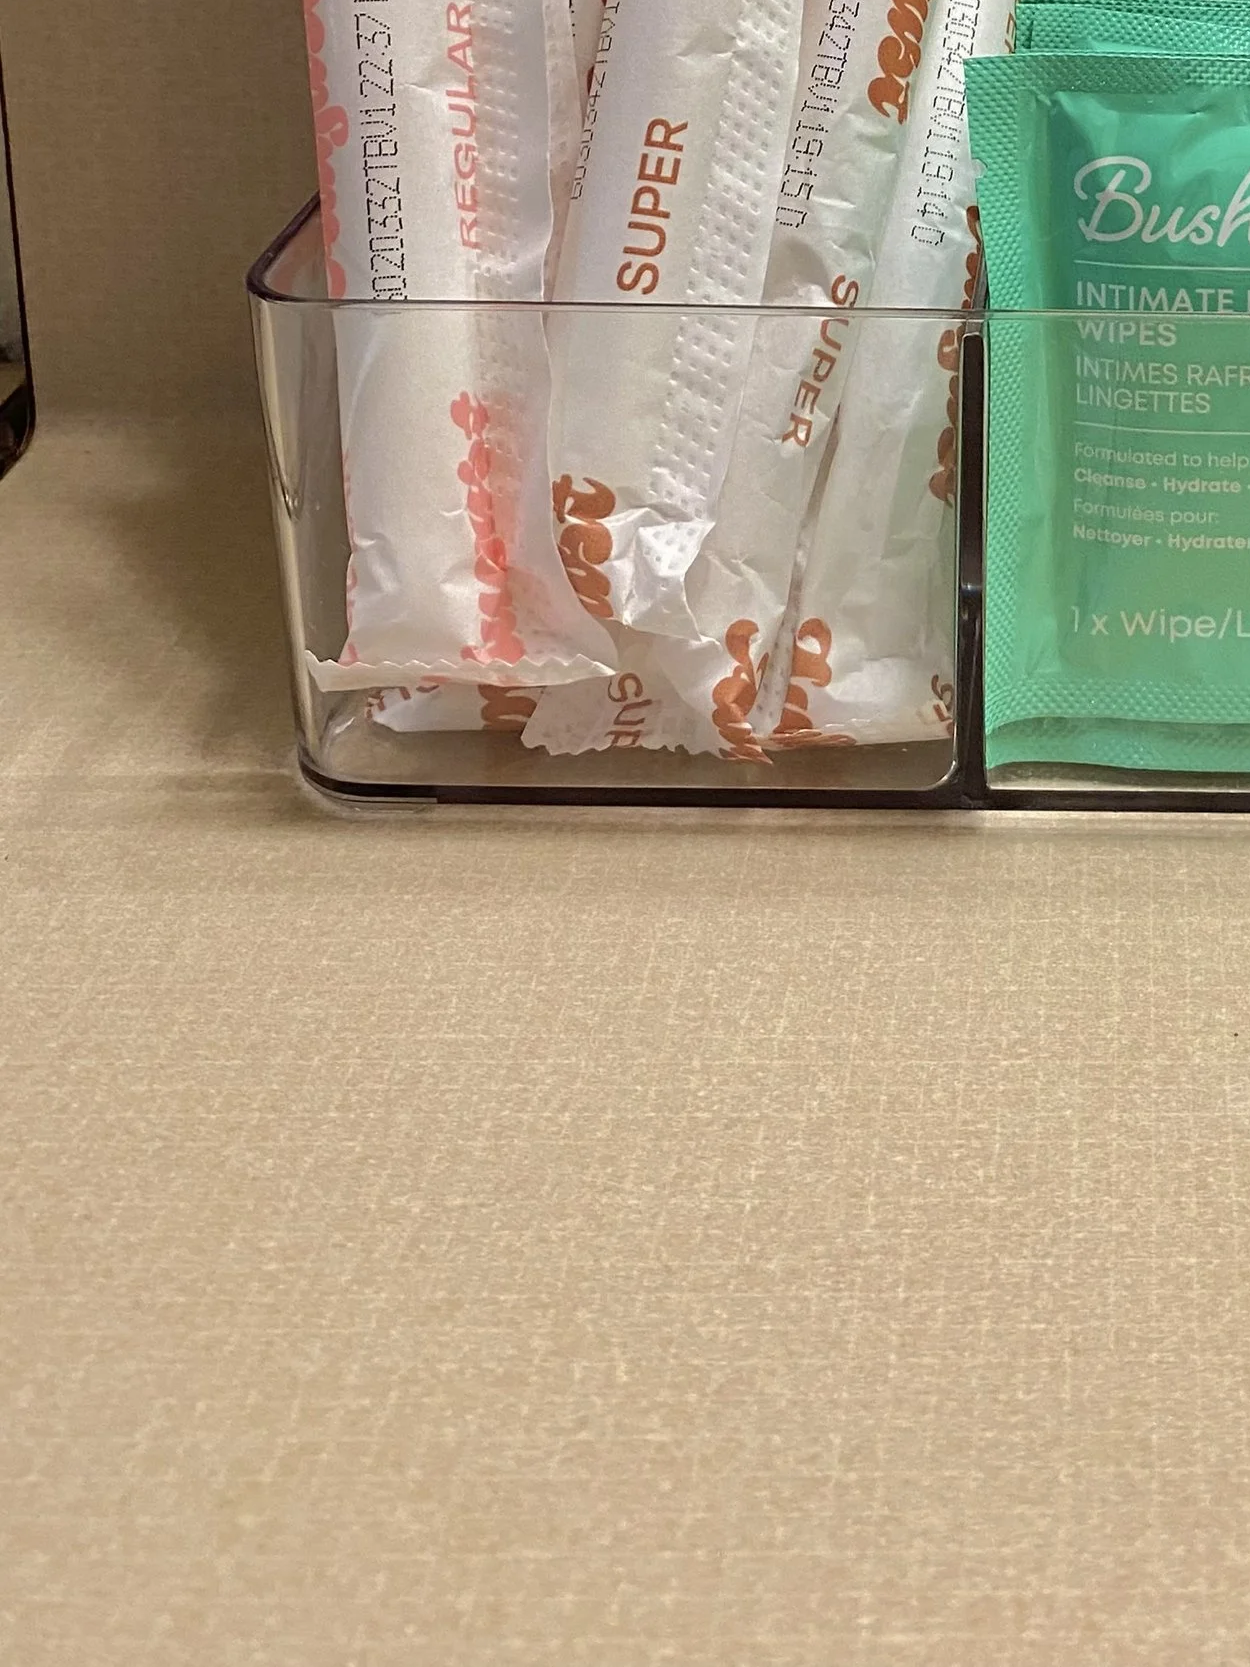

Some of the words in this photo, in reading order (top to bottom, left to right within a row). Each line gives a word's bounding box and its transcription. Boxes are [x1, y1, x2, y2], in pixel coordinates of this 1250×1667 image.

[446, 1, 481, 249] REGULAR
[616, 118, 689, 296] SUPER
[1076, 280, 1234, 315] INTIMATE
[1077, 319, 1177, 347] WIPES
[780, 274, 860, 449] SUPER
[1076, 355, 1177, 385] INTIMES
[1076, 384, 1211, 414] LINGETTES
[1074, 442, 1177, 467] Formulated
[1183, 453, 1202, 467] to
[1074, 467, 1146, 489] Cleanse
[1163, 475, 1241, 495] Hydrate
[1170, 508, 1219, 526] pour:
[1073, 524, 1152, 547] Nettoyer
[1072, 606, 1080, 633] 1
[1091, 613, 1109, 635] x
